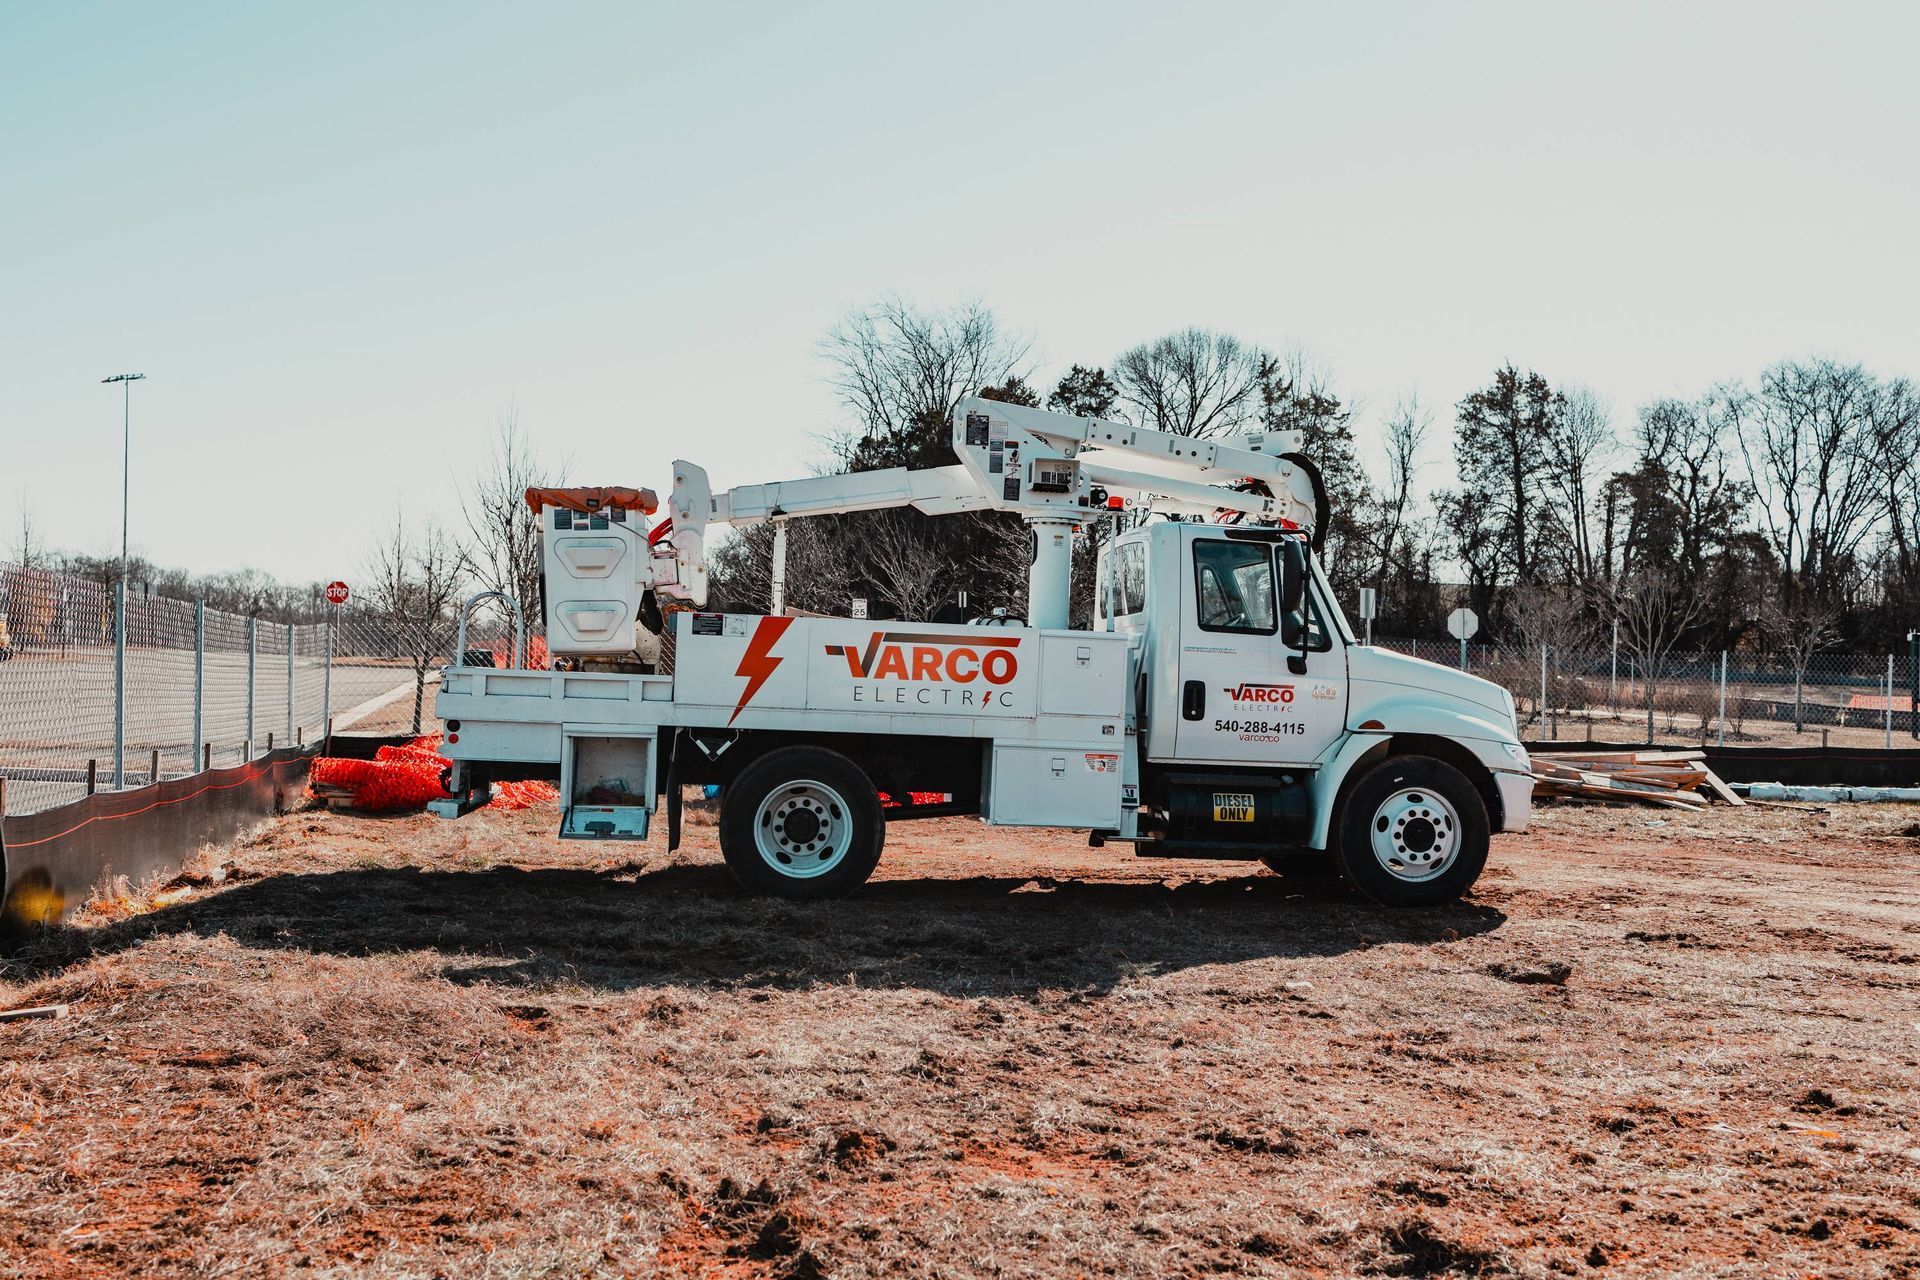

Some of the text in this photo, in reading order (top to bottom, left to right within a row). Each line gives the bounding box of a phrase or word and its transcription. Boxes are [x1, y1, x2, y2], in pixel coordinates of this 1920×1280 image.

[327, 587, 348, 597] STOP
[854, 608, 866, 616] 25
[844, 632, 1018, 685] VARCO
[853, 686, 1014, 710] ELECTRIC
[1230, 683, 1295, 703] VARCO
[1234, 703, 1294, 713] ELECTRIC
[1214, 720, 1305, 735] 540-288-4115
[1239, 733, 1280, 743] varco.co
[1214, 794, 1254, 807] DIESEL
[1220, 807, 1249, 821] ONLY
